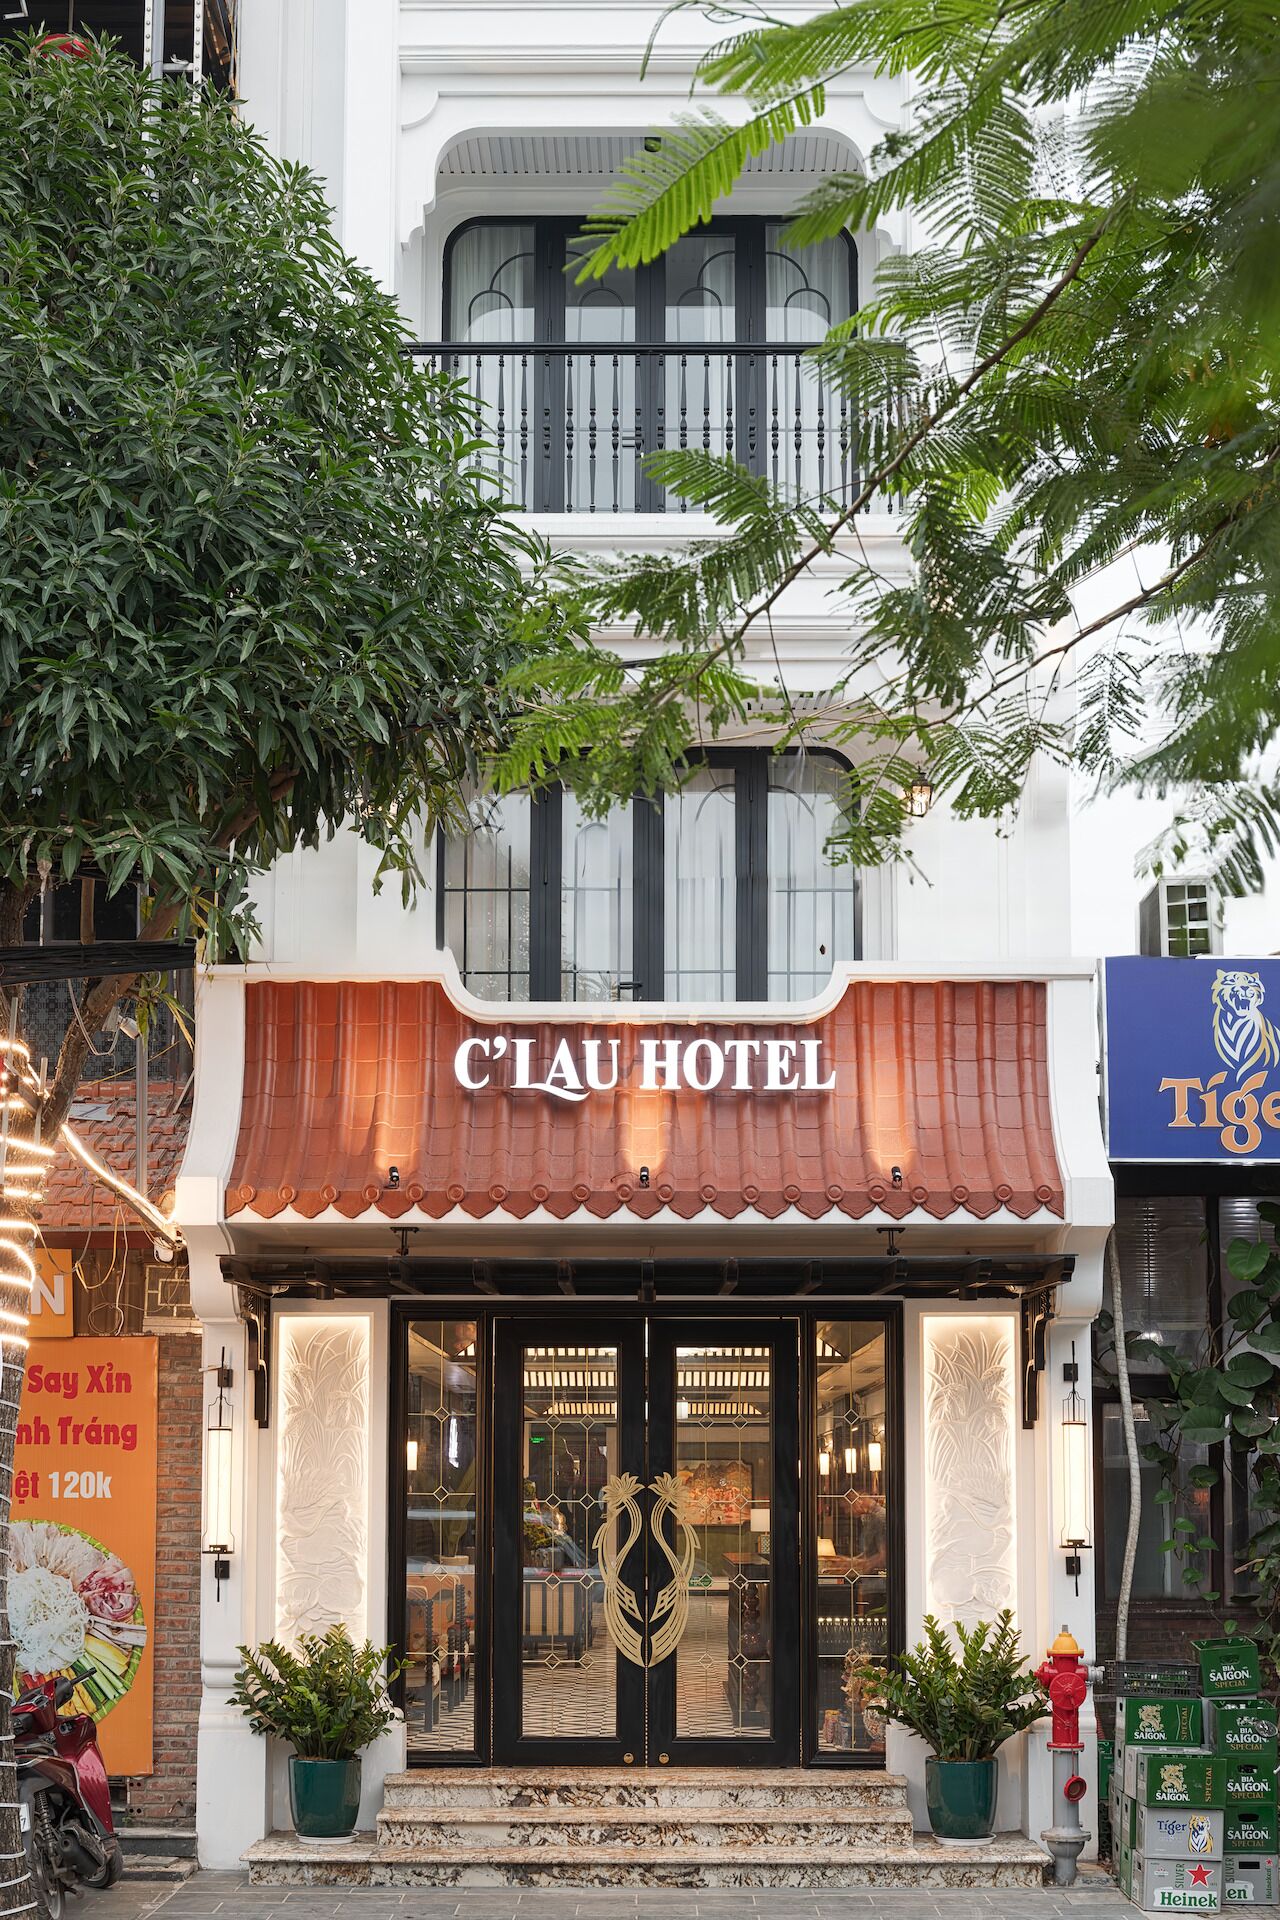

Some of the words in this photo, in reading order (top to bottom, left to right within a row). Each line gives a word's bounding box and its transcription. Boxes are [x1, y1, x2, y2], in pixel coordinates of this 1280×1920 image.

[639, 1038, 837, 1091] HOTEL
[30, 1274, 65, 1315] N
[27, 1364, 79, 1400] Say
[85, 1361, 132, 1394] Xỉn
[16, 1415, 51, 1445] nh
[57, 1415, 138, 1451] Tráng
[10, 1470, 39, 1504] ệt
[48, 1471, 112, 1499] 120k
[1209, 1669, 1250, 1682] SAIGON
[1214, 1680, 1247, 1689] SPECIAL
[1134, 1732, 1166, 1740] SAIGON
[1225, 1733, 1267, 1743] SAIGON
[1230, 1743, 1264, 1751] SPECIAL
[1227, 1782, 1269, 1792] SAIGON
[1155, 1792, 1189, 1801] SAIGON
[1231, 1791, 1264, 1799] SPECIAL
[1157, 1820, 1187, 1836] Tiger
[1227, 1830, 1269, 1840] SAIGON
[1231, 1840, 1264, 1848] SPECIAL
[1225, 1857, 1235, 1883] SILVER
[1175, 1863, 1185, 1889] SILVER
[1225, 1888, 1247, 1899] en
